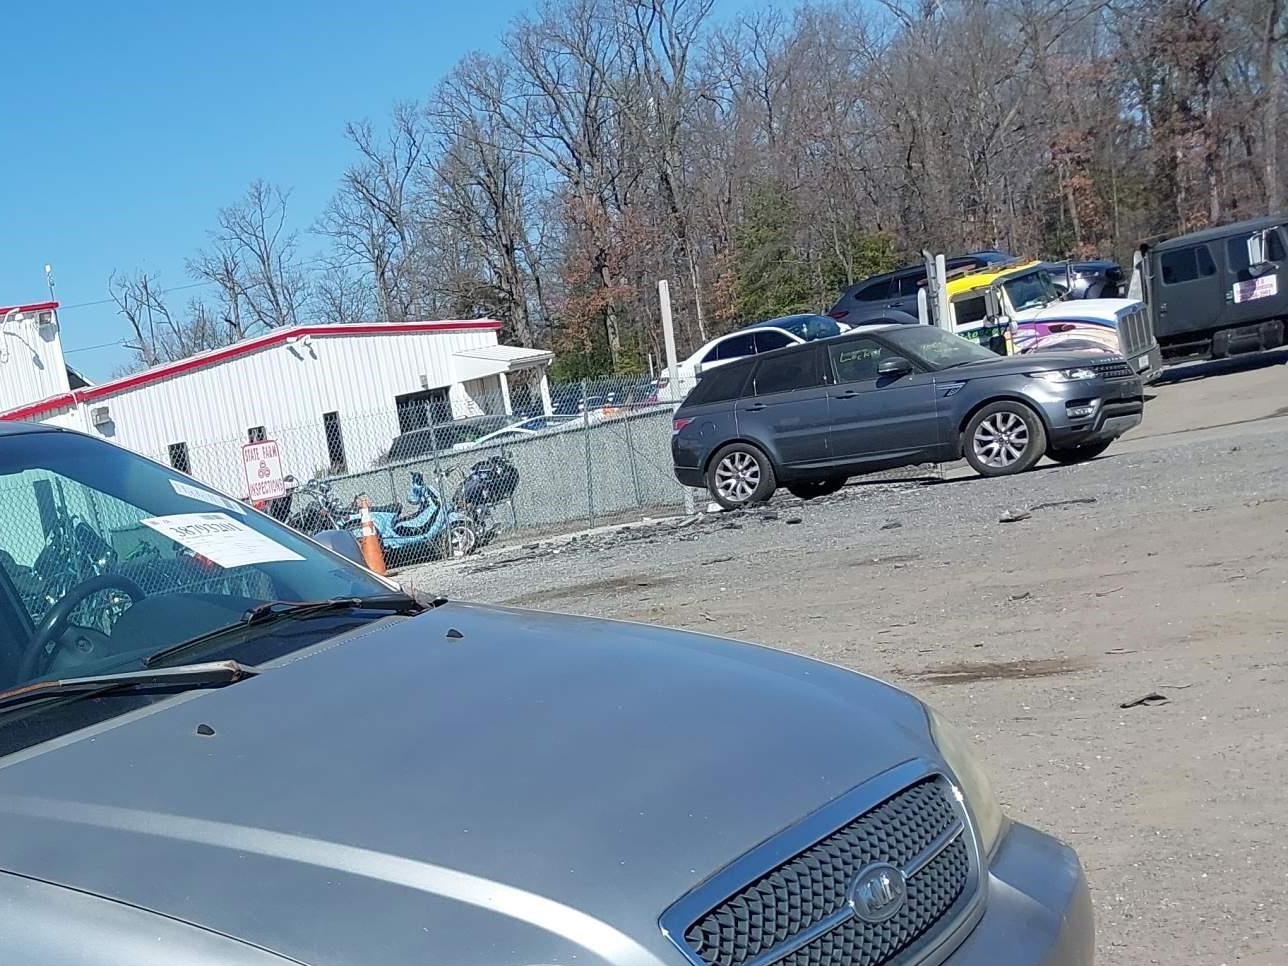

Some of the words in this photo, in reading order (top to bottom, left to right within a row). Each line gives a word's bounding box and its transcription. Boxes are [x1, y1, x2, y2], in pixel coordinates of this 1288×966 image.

[244, 446, 260, 462] STATE
[262, 442, 278, 459] FARM
[249, 479, 284, 498] INSPECTIONS
